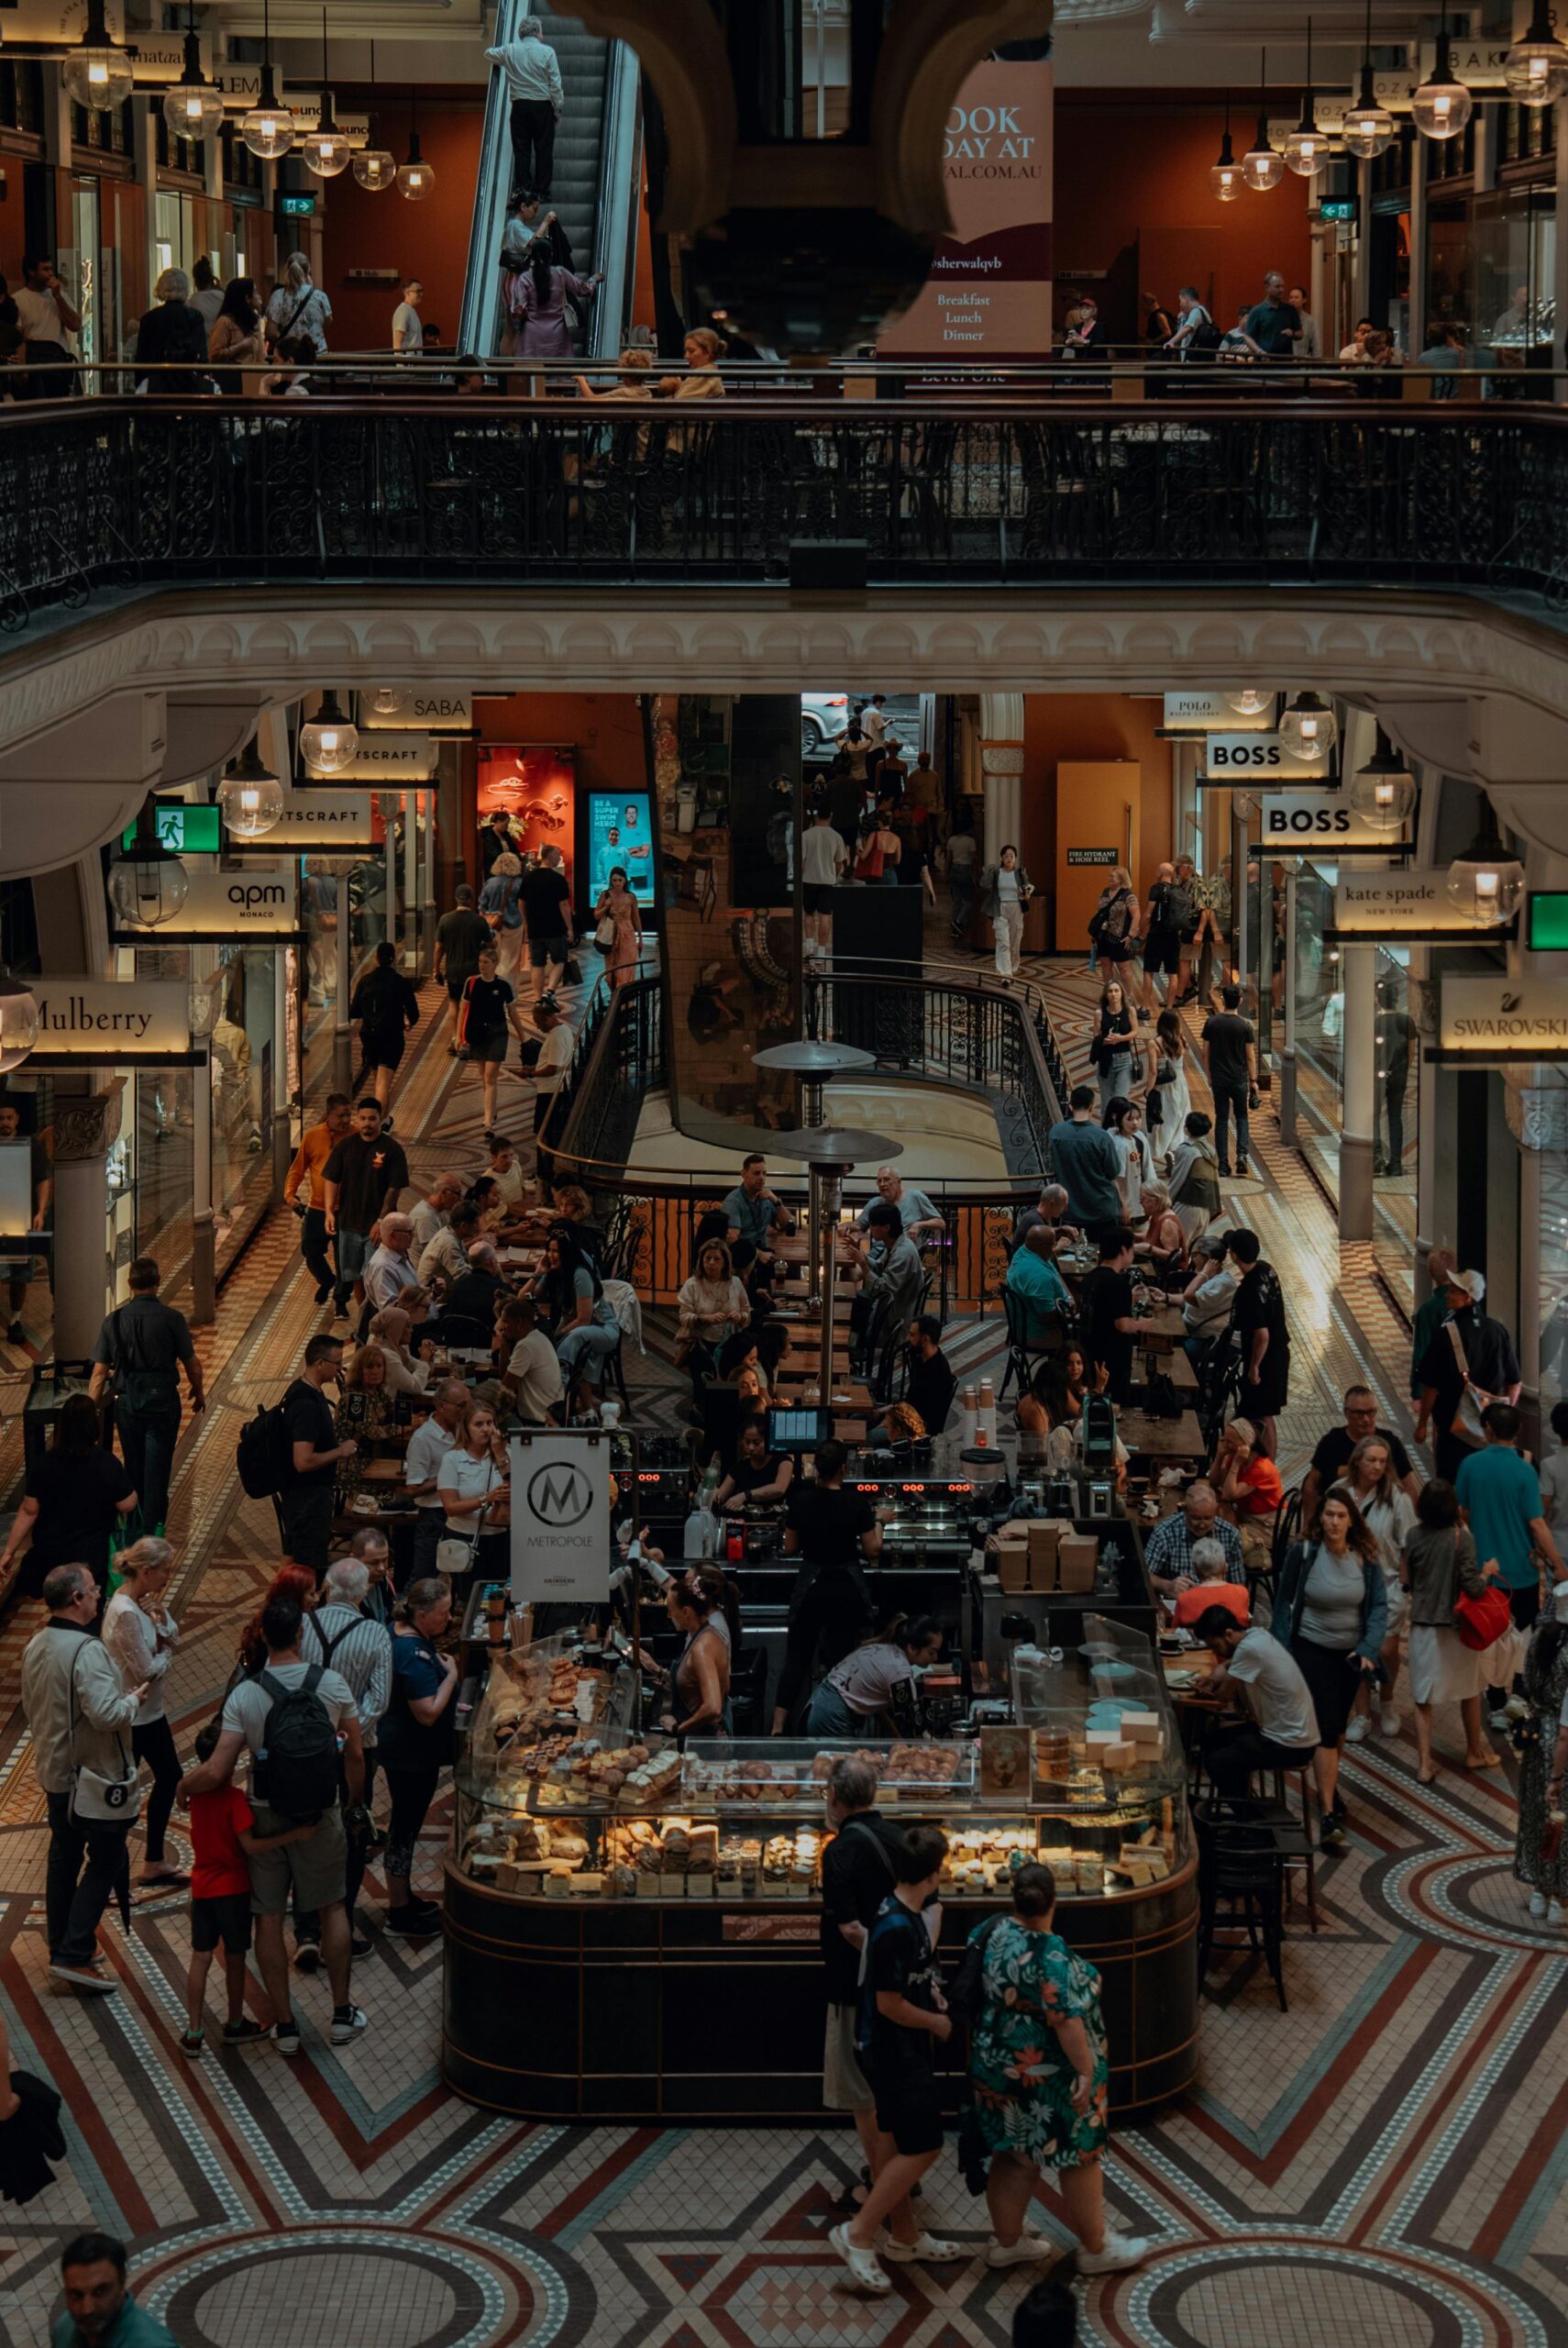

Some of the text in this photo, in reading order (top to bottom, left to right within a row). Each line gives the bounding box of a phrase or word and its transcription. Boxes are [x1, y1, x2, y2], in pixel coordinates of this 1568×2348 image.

[998, 138, 1034, 159] AT
[944, 165, 1042, 180] AL.COM.AU
[937, 293, 990, 306] Breakfast
[945, 311, 982, 324] Lunch
[943, 329, 984, 342] Dinner
[414, 700, 466, 716] SABA
[1179, 702, 1210, 711] POLO
[1214, 746, 1280, 765] BOSS
[1270, 810, 1350, 832] BOSS
[228, 886, 285, 910] apm
[1345, 885, 1436, 903] kate spade
[20, 996, 152, 1037] Mulberry
[1453, 1018, 1567, 1036] SWAROVSKI
[527, 1535, 593, 1547] METROPOLE
[110, 1787, 123, 1805] 8
